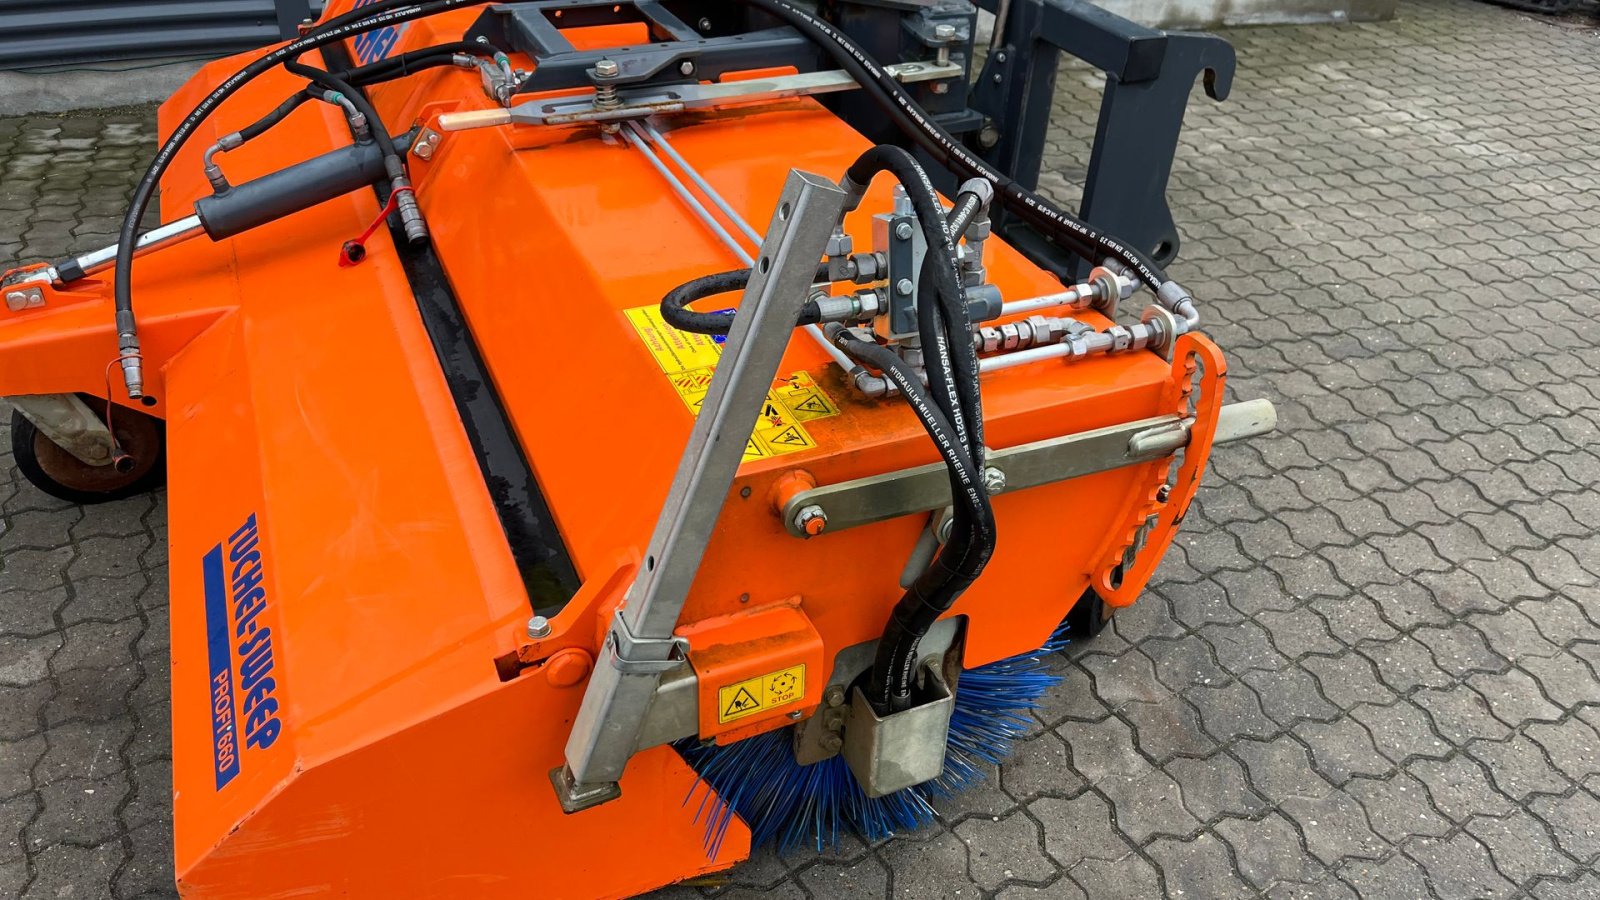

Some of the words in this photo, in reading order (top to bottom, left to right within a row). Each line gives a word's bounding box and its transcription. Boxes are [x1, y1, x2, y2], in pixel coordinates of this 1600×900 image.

[914, 164, 944, 215] HANSA-FLEX
[940, 220, 949, 234] HD
[1123, 250, 1133, 260] 213
[1130, 257, 1140, 266] HD
[1138, 264, 1162, 289] ANSA-FLEX
[937, 336, 958, 407] HANSA-FLEX
[953, 408, 967, 443] HD213
[890, 365, 921, 404] HYDRAULIK
[919, 403, 950, 449] MUELLER
[947, 449, 970, 484] RHEINE
[228, 511, 282, 750] TUCHEL-SWEEP
[213, 668, 232, 736] PROFI
[771, 692, 794, 704] STOP
[216, 732, 235, 773] 660
